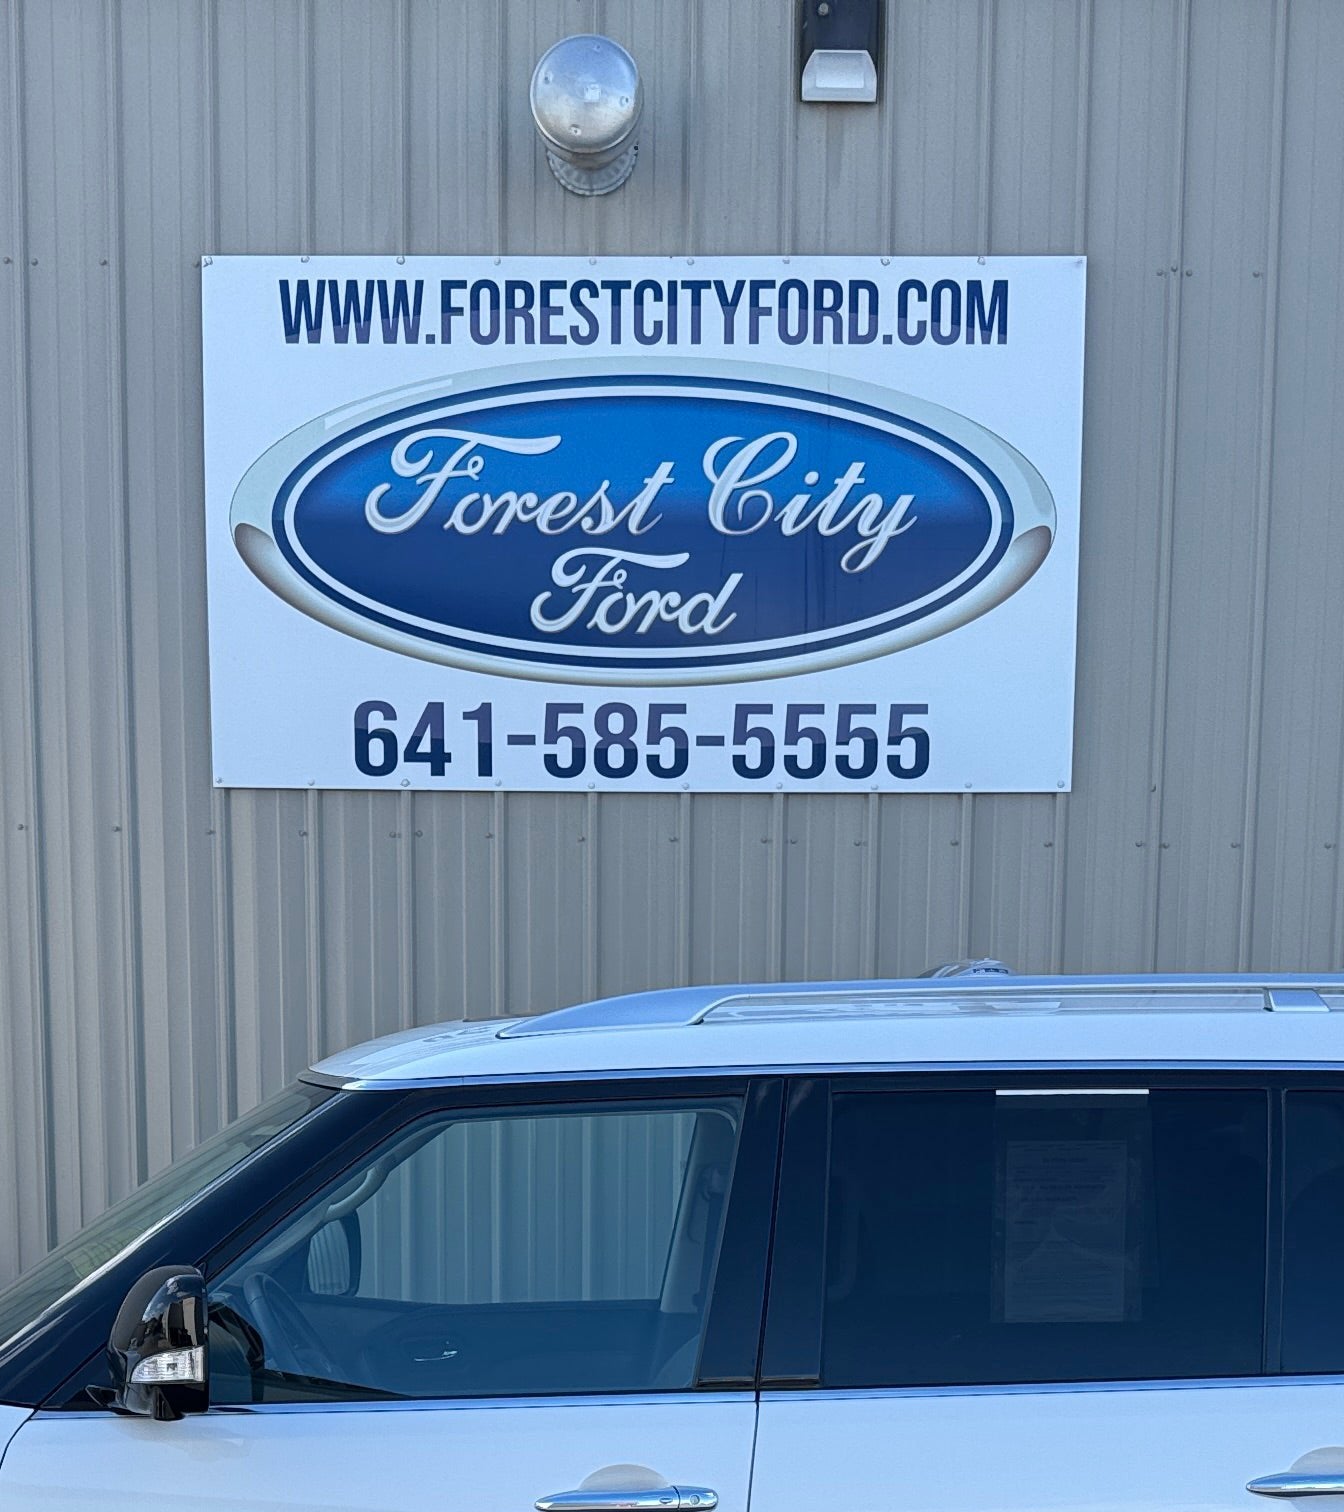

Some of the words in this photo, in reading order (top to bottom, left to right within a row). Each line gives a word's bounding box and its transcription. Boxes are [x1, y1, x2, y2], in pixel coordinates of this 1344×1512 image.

[279, 278, 1010, 346] WWW.FORESTCITYFORD.COM
[364, 428, 675, 536] Forest
[701, 431, 917, 574] City
[529, 546, 744, 636] Ford
[352, 700, 931, 779] 641-585-5555
